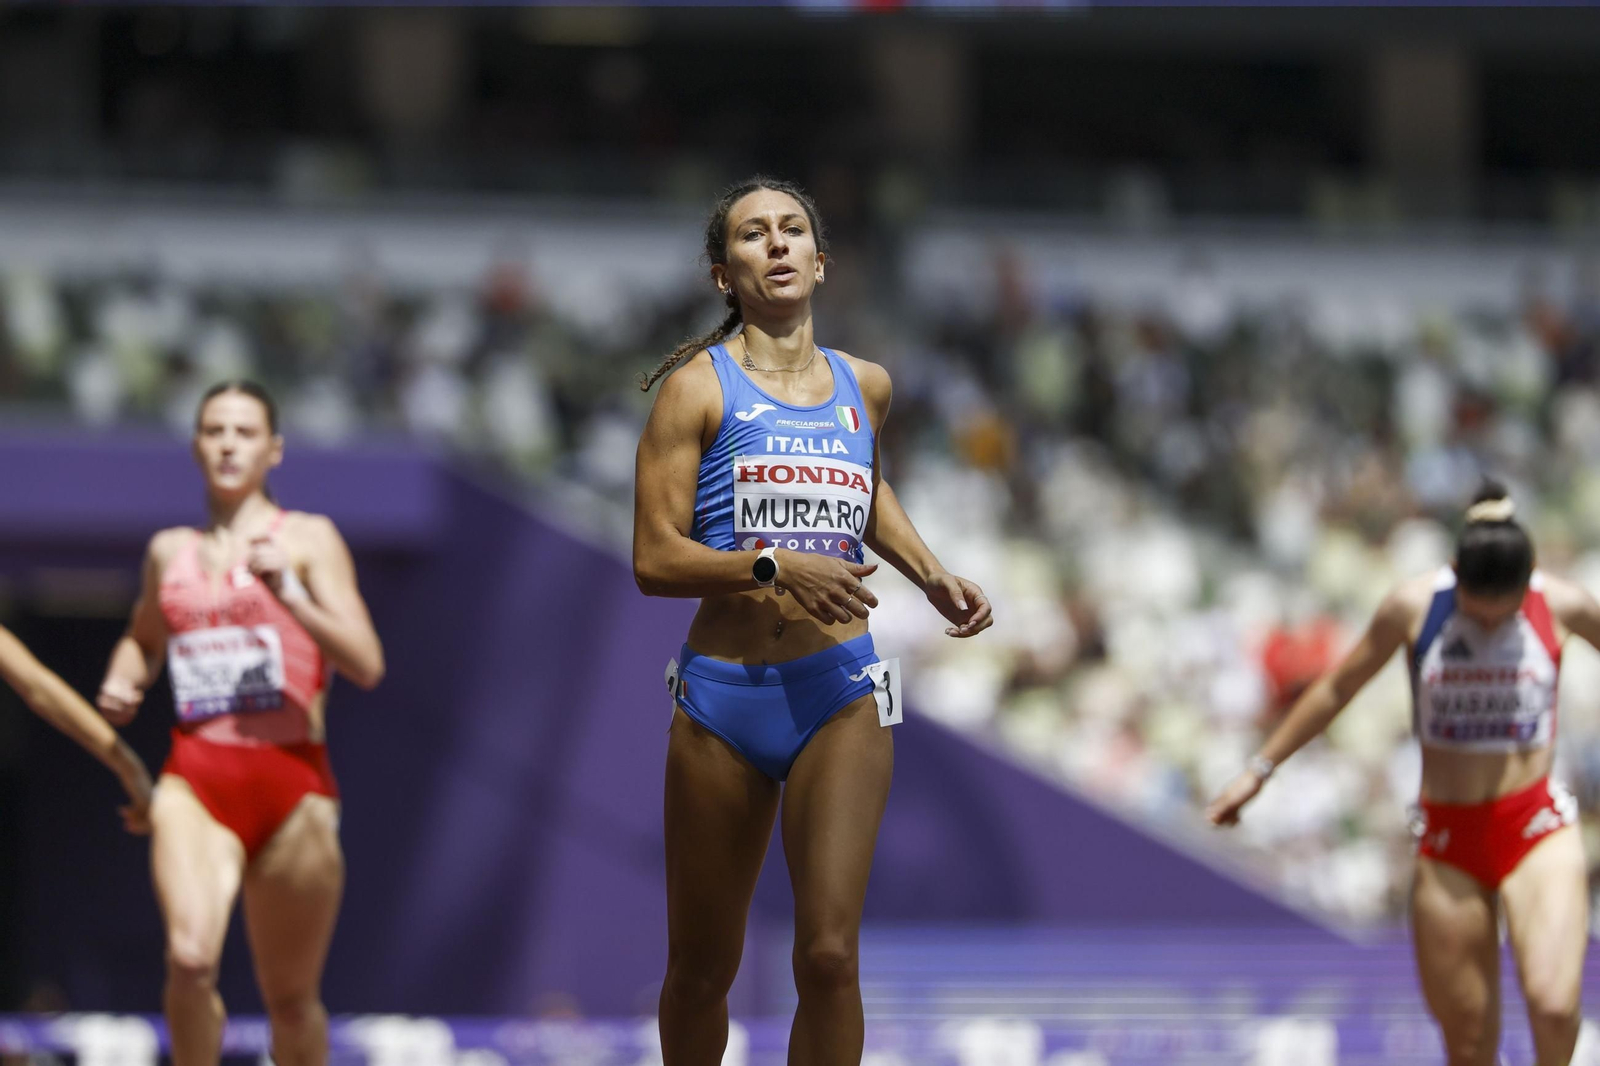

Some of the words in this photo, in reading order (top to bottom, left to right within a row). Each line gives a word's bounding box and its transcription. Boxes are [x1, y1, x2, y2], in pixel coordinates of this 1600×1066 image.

[776, 419, 835, 427] FRECCIAROSSA
[766, 436, 849, 454] ITALIA
[738, 465, 870, 494] HONDA
[742, 498, 865, 535] MURARO
[883, 671, 893, 716] 3
